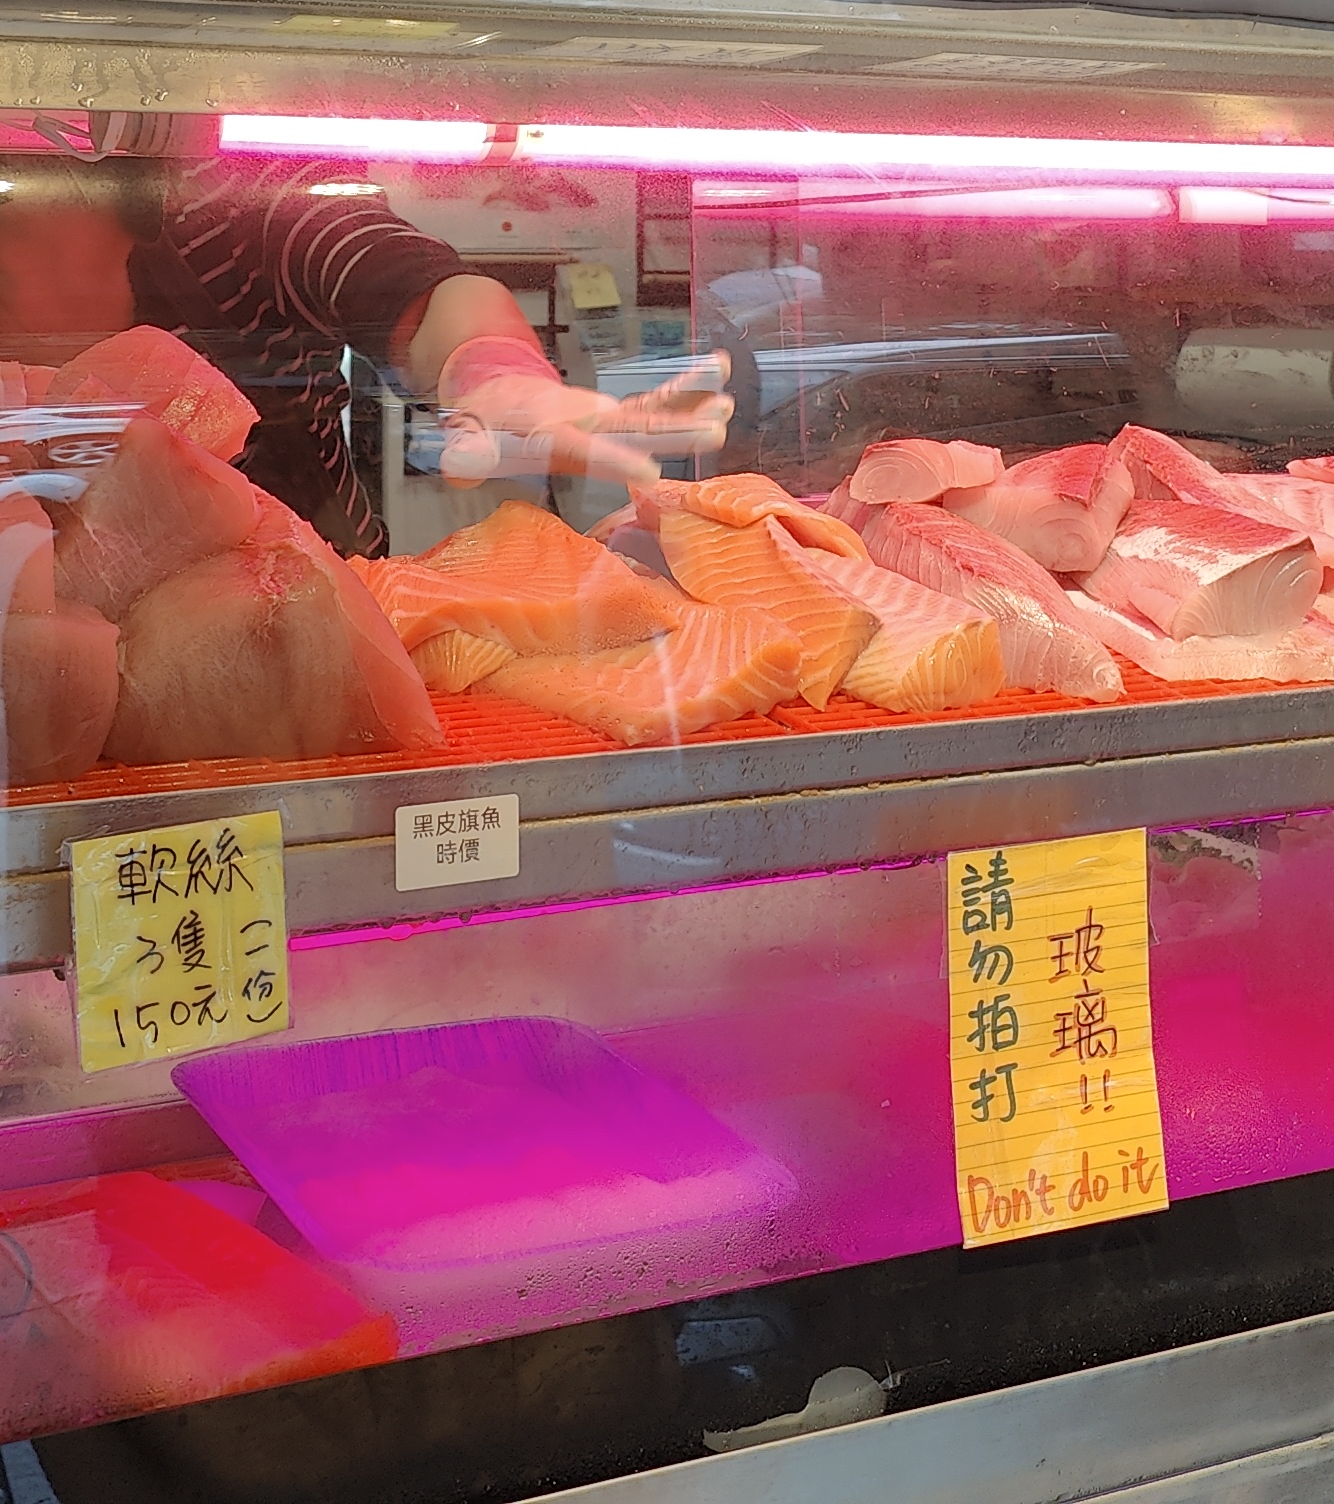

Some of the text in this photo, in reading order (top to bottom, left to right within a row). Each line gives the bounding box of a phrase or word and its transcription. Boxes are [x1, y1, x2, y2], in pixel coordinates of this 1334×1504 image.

[413, 806, 501, 839] 黑皮旗魚
[437, 838, 480, 864] 時價
[115, 827, 254, 905] 軟絲
[114, 985, 228, 1047] 150元
[960, 850, 1019, 1123] 請勿拍打
[967, 1146, 1159, 1234] Don't do it
